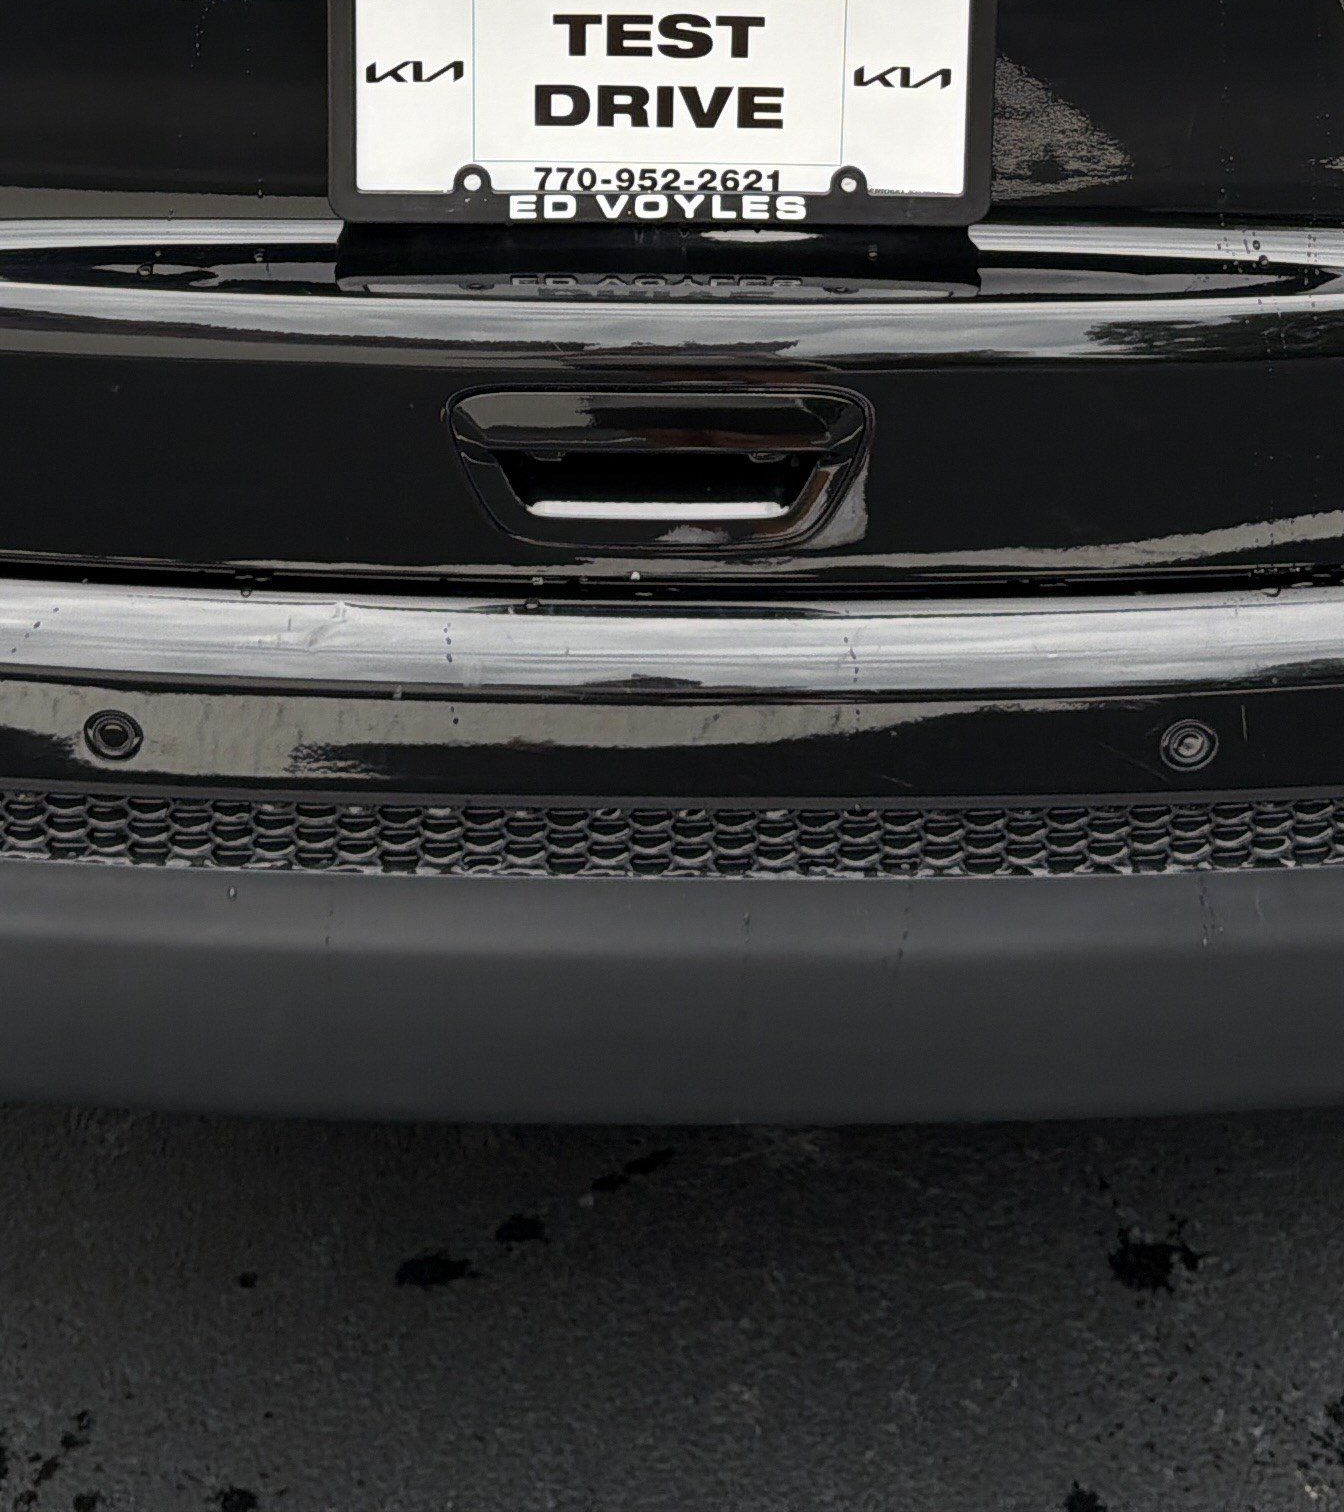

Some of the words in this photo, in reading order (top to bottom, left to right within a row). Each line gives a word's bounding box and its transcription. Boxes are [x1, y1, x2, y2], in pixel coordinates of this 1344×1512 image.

[552, 13, 766, 59] TEST
[533, 84, 784, 130] DRIVE
[534, 166, 781, 193] 770-952-2621
[508, 195, 577, 220] ED
[596, 194, 807, 220] VOYLES
